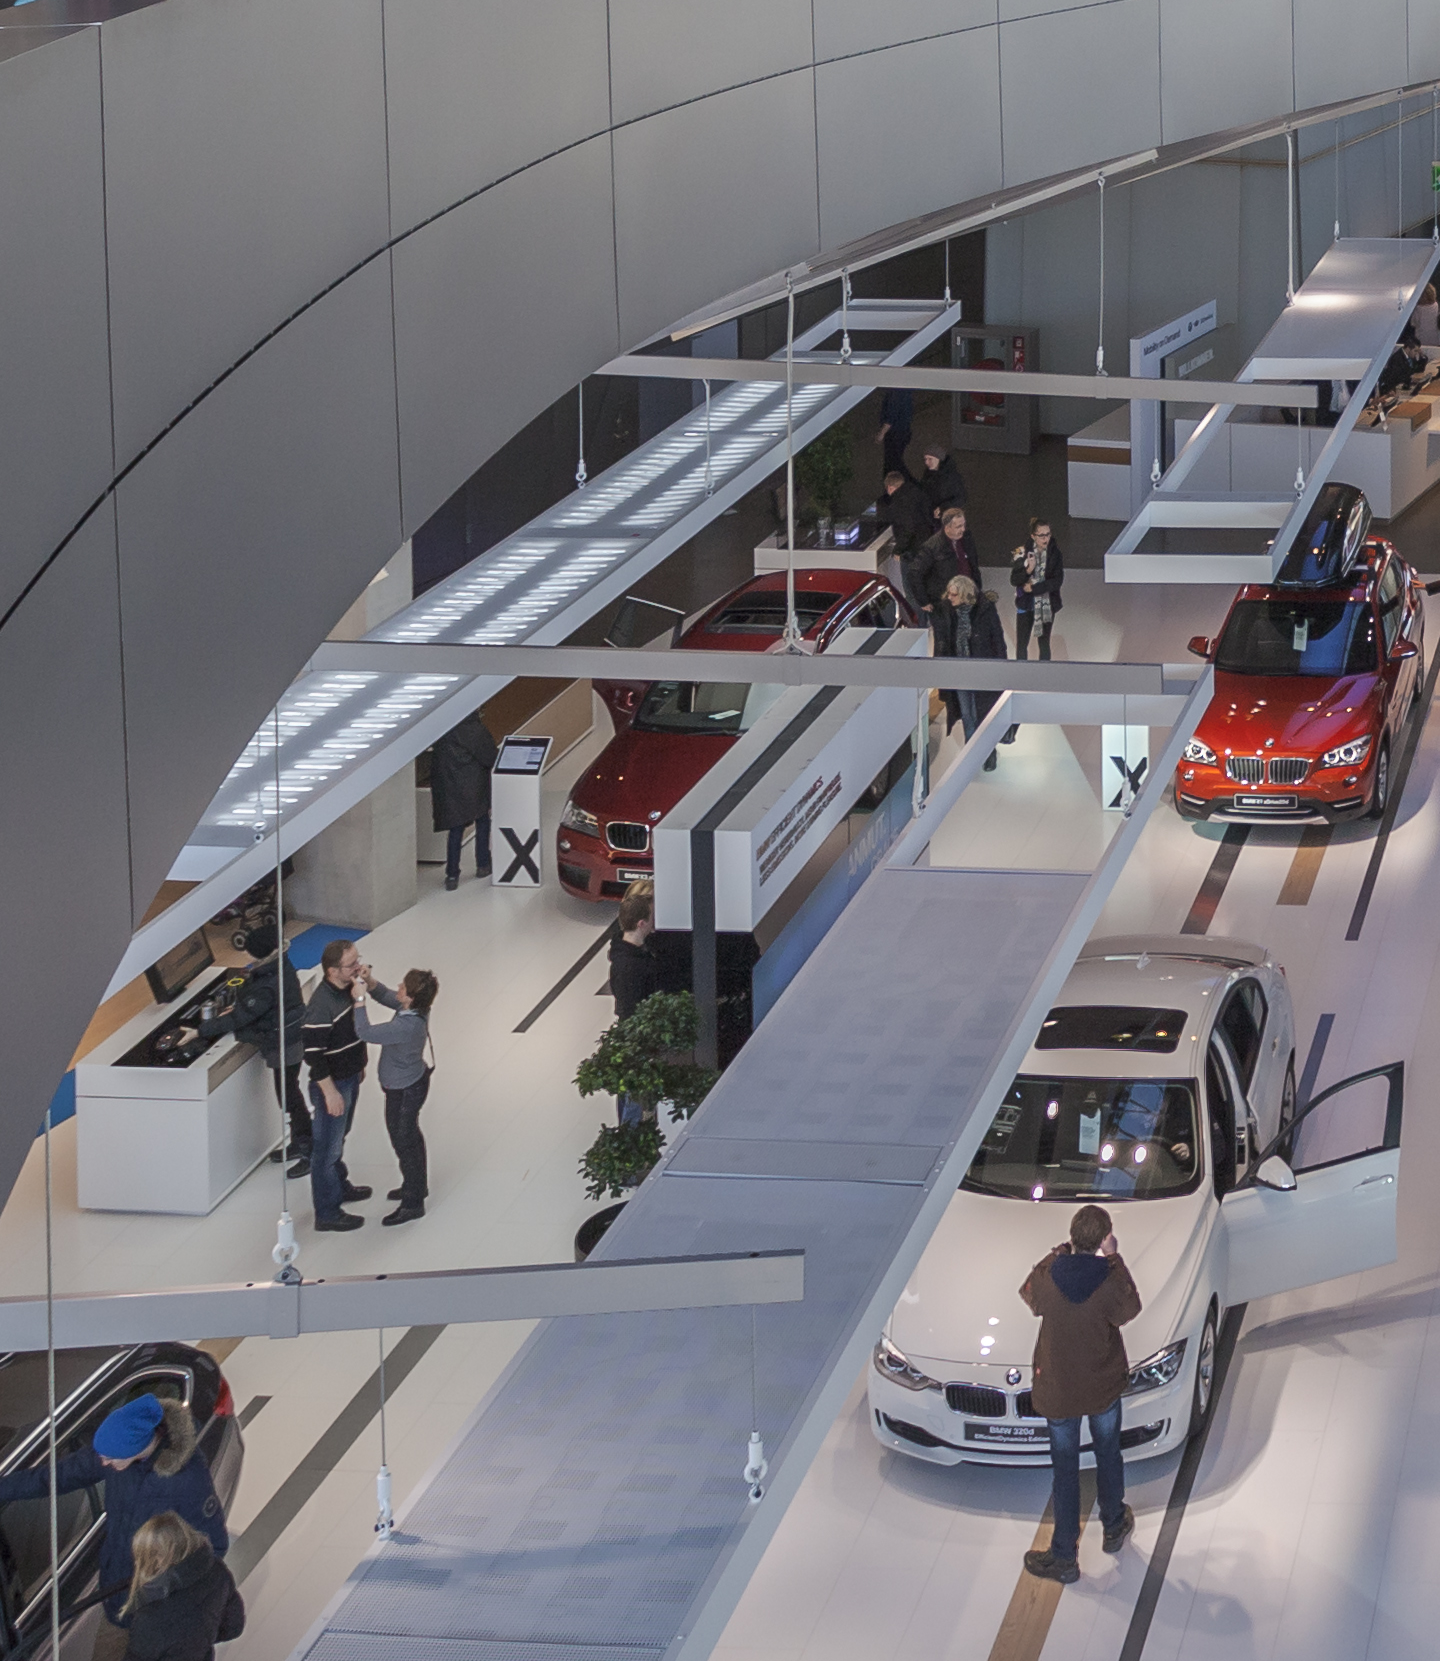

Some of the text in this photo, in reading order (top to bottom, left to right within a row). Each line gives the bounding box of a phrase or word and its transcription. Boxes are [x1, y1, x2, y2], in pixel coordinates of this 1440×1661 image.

[498, 827, 540, 884] X
[989, 1426, 1035, 1436] BMW 320d
